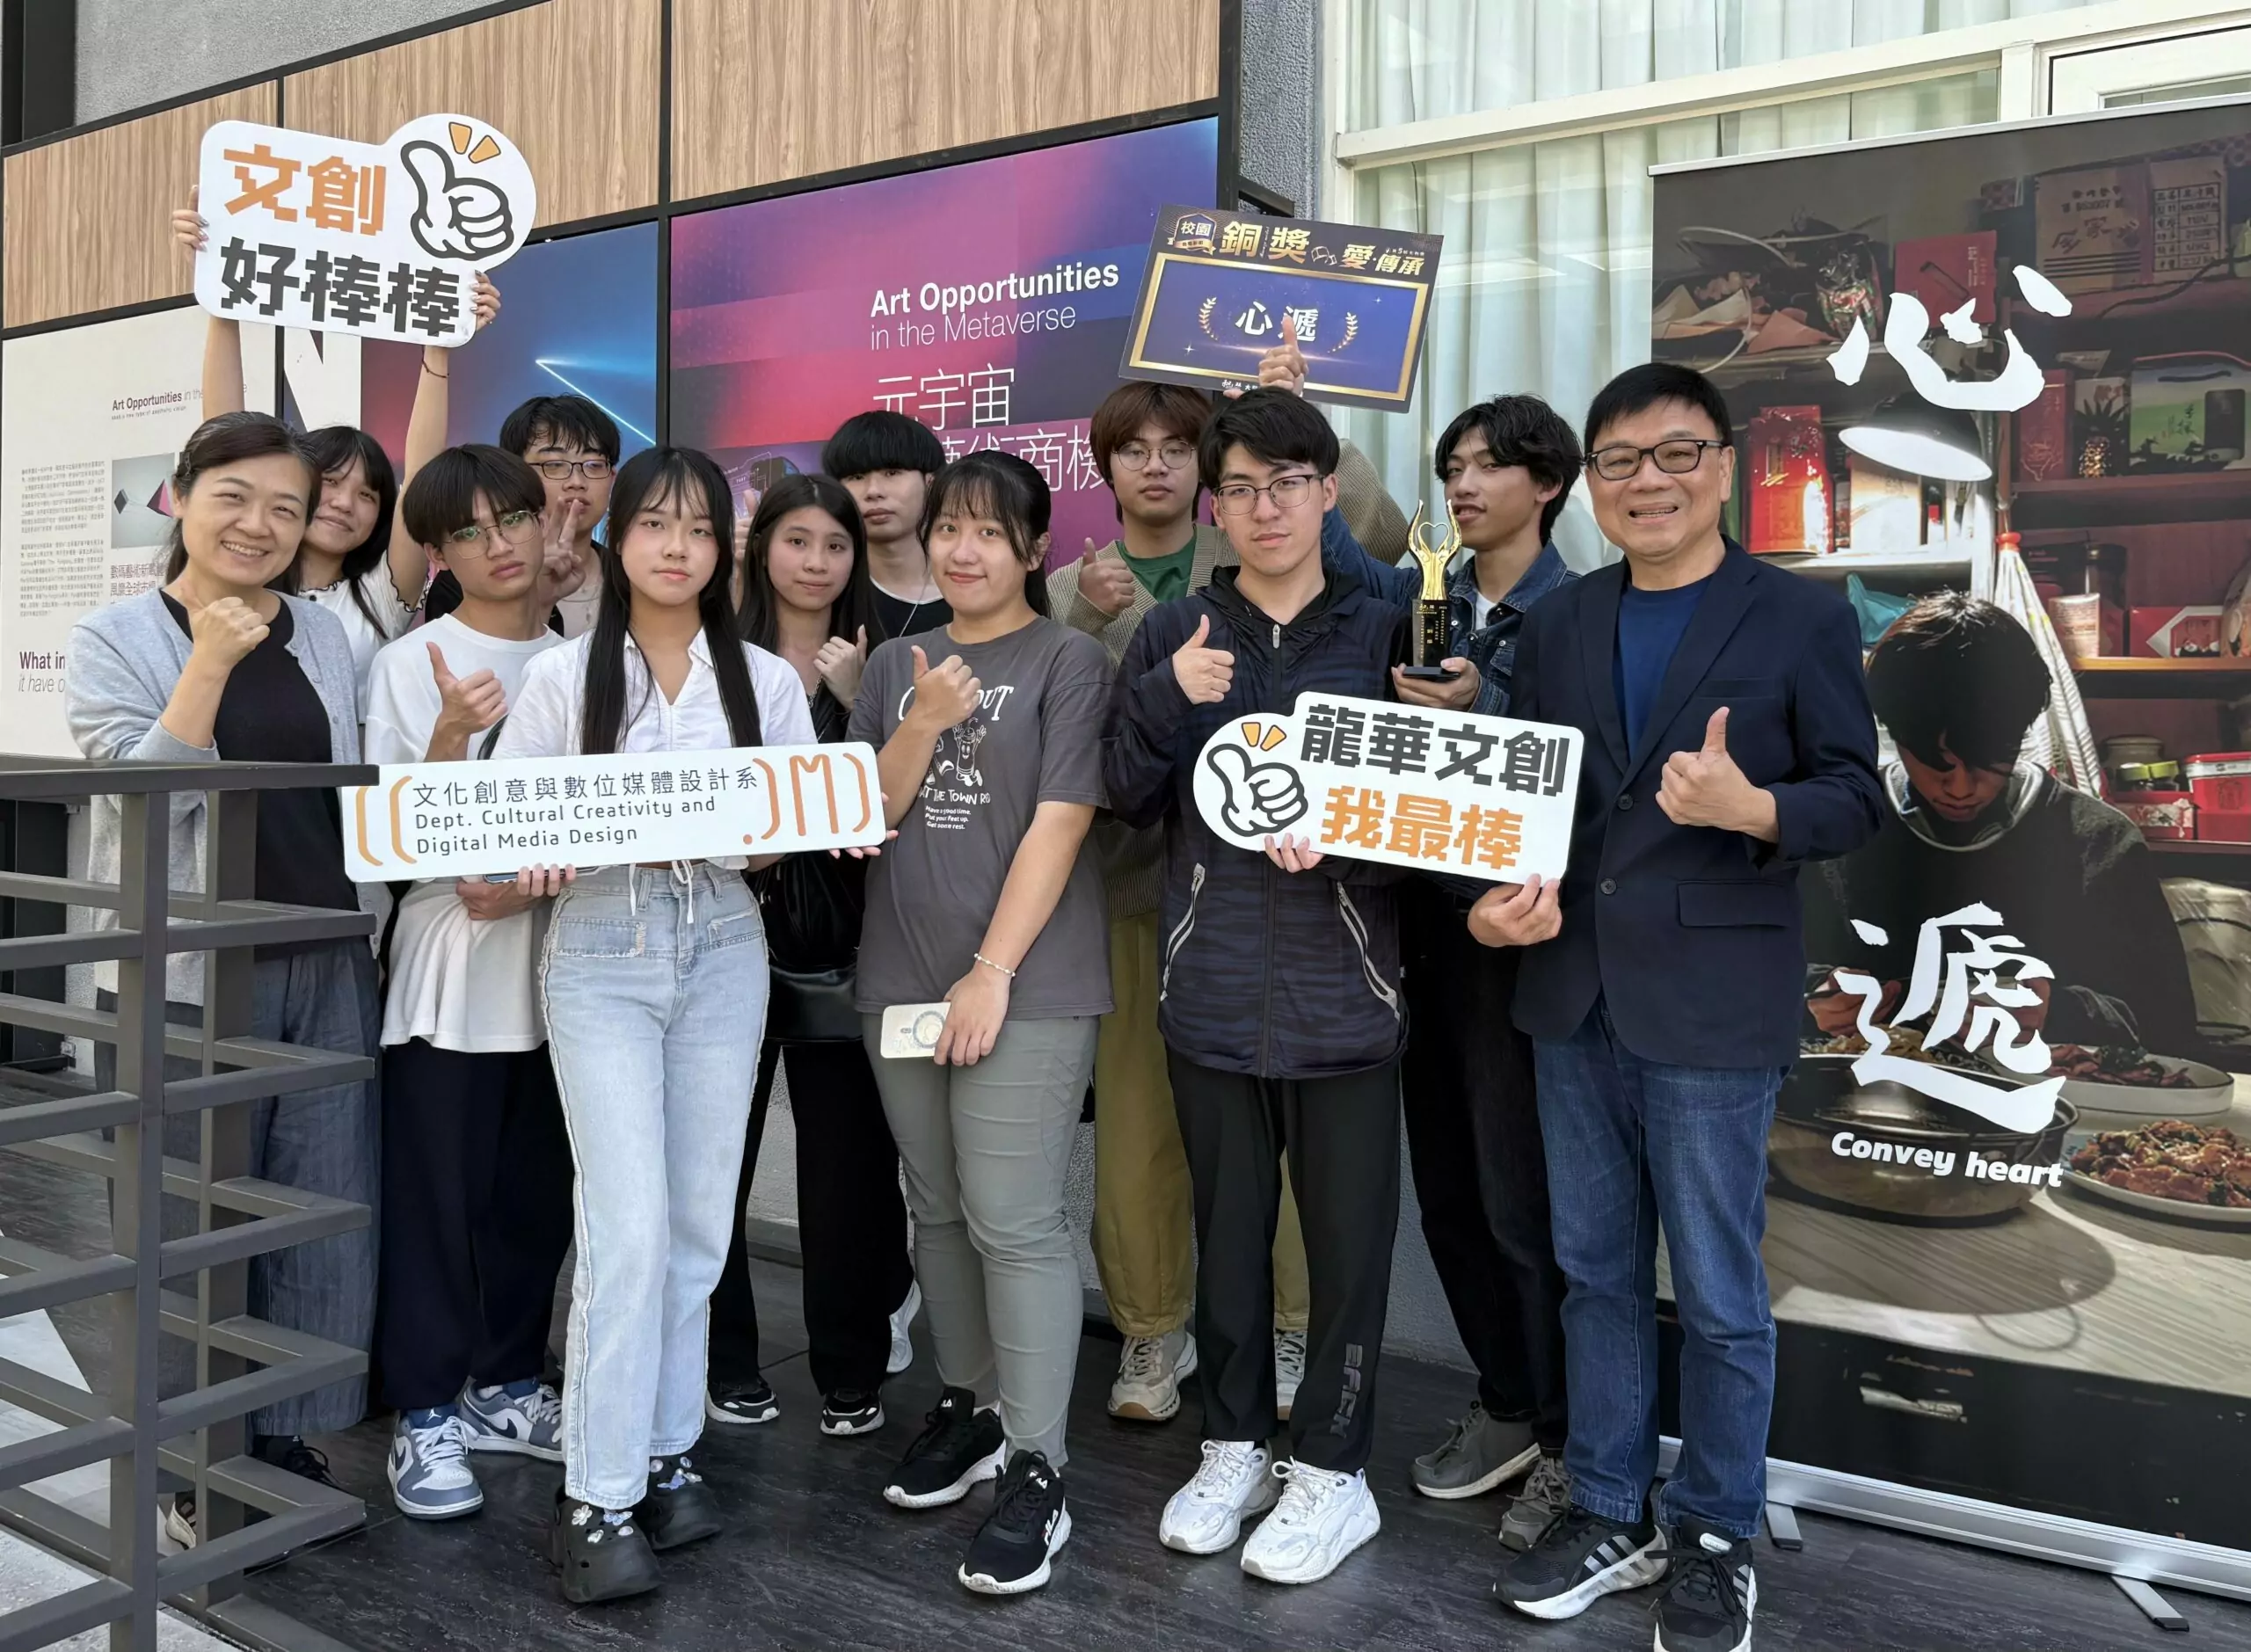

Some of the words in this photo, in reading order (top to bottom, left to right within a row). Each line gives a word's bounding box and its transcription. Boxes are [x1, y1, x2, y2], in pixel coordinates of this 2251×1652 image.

[223, 143, 387, 236] 文創
[1180, 221, 1213, 237] 校園
[1219, 220, 1311, 264] 銅獎
[221, 236, 460, 337] 好棒棒
[871, 287, 910, 317] Art
[920, 263, 1119, 314] Opportunities
[871, 328, 890, 350] in
[898, 321, 936, 348] the
[944, 306, 1076, 342] Metaverse
[112, 399, 125, 411] Art
[127, 391, 183, 411] Opportunities
[184, 389, 192, 401] in
[873, 363, 1015, 431] 元宇宙
[19, 651, 51, 669] What
[18, 673, 25, 692] it
[28, 673, 55, 692] have
[1300, 703, 1570, 797] 龍華文創
[413, 767, 758, 809] 文化創意與數位媒體設計系
[925, 805, 939, 814] Have
[948, 789, 978, 805] TOWN
[416, 812, 473, 831] Dept.
[482, 805, 565, 826] Cultural
[573, 800, 673, 820] Creativity
[681, 797, 716, 813] and
[1320, 785, 1523, 870] 我最棒
[417, 833, 488, 856] Digital
[498, 830, 560, 850] Media
[570, 826, 637, 845] Design
[1831, 1132, 1956, 1176] Convey
[1964, 1153, 2065, 1188] heart
